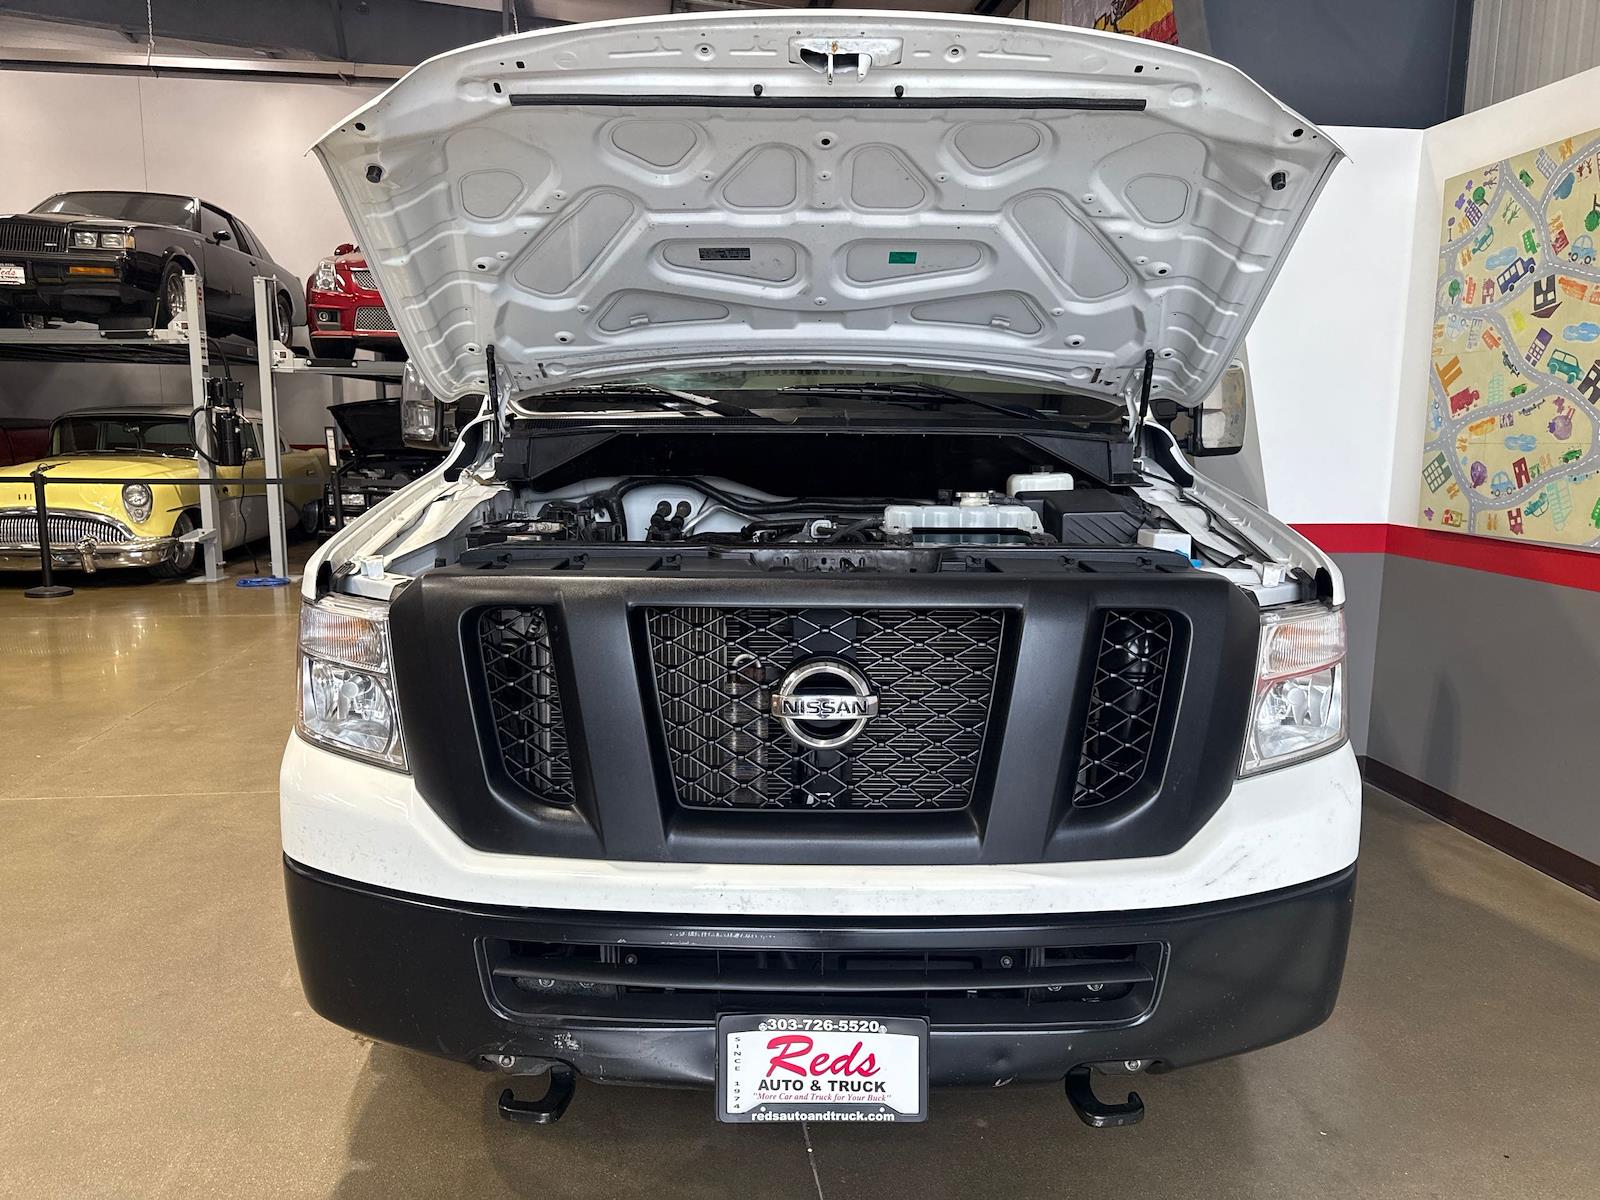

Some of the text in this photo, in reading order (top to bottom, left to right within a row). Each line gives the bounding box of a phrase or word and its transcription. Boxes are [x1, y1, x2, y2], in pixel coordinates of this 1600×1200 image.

[783, 700, 867, 714] NISSAN
[767, 1019, 879, 1032] 303-726-5520
[766, 1035, 881, 1077] Reds
[758, 1079, 887, 1093] AUTO & TRUCK
[779, 1092, 793, 1100] Car
[795, 1092, 809, 1100] and
[810, 1093, 832, 1101] Truck
[833, 1093, 846, 1103] for
[847, 1094, 865, 1102] Your
[751, 1110, 895, 1121] redsautoandtruck.com
